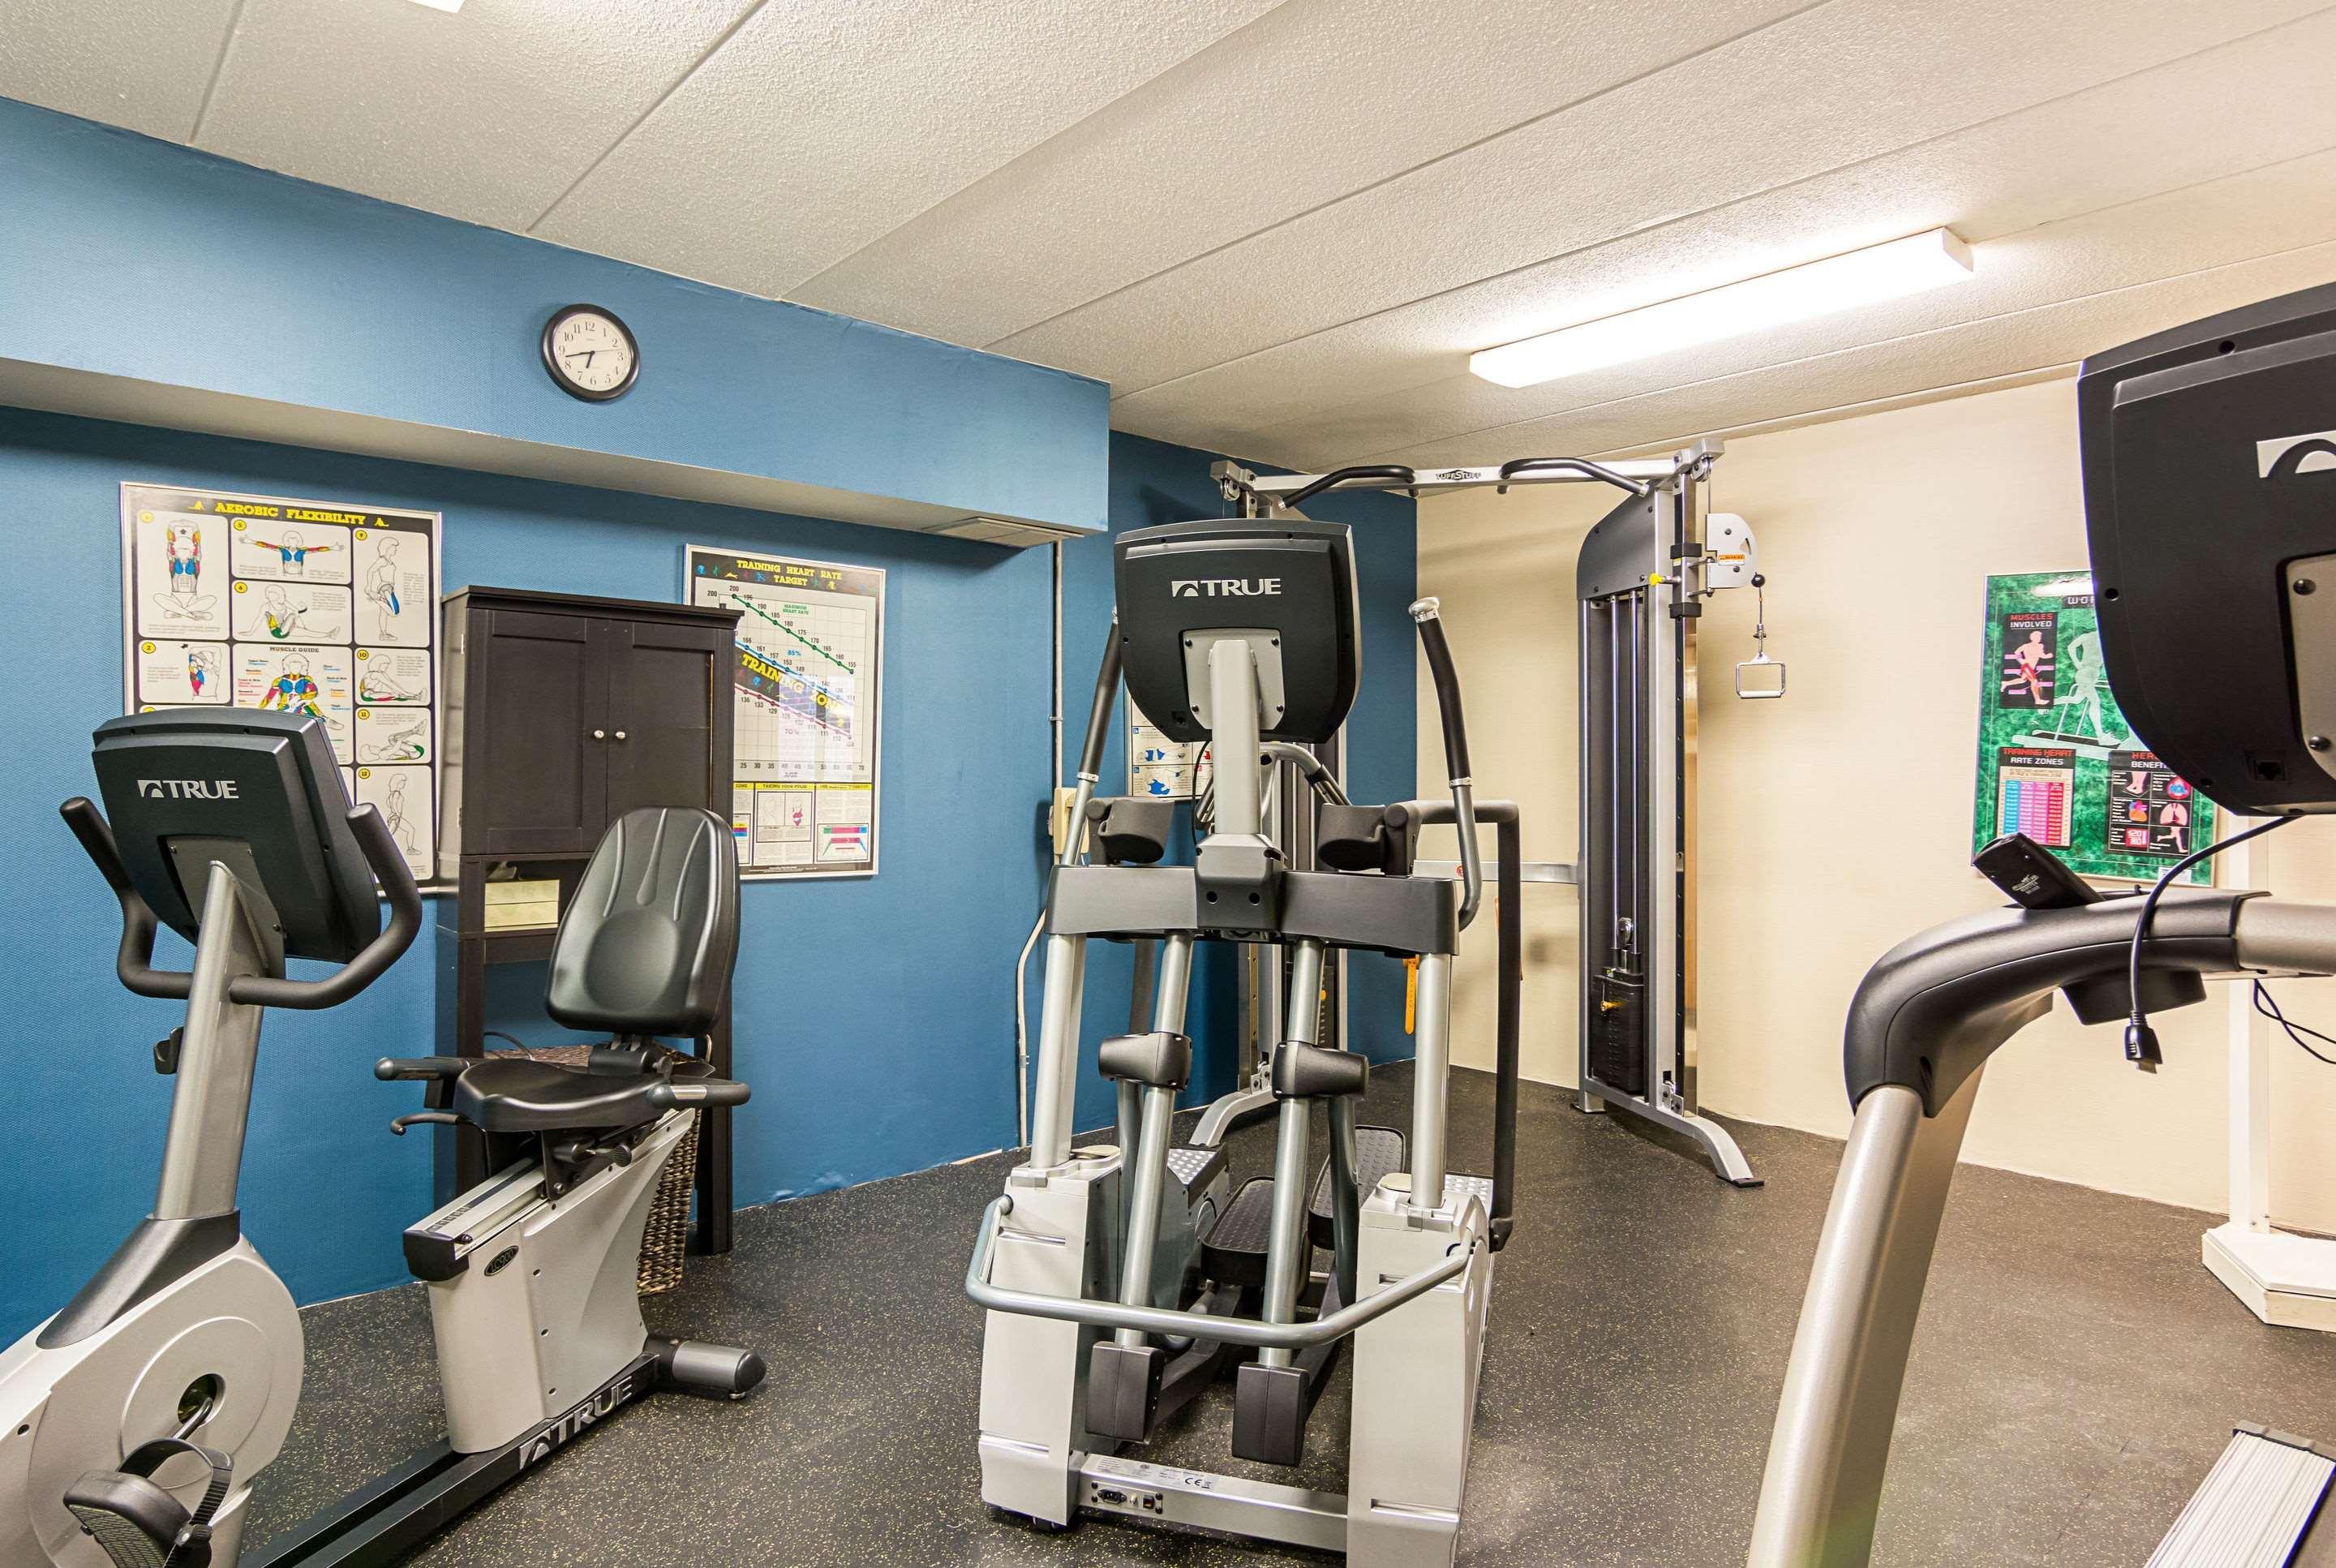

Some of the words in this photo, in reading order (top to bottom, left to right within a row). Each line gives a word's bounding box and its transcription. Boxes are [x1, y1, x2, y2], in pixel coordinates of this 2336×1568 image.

[573, 324, 581, 334] 11
[585, 321, 595, 332] 12
[603, 327, 608, 337] 1
[564, 332, 574, 342] 10
[612, 338, 618, 348] 2
[558, 346, 565, 356] 9
[617, 351, 624, 362] 3
[565, 359, 572, 371] 8
[577, 371, 584, 381] 7
[590, 376, 597, 385] 6
[604, 374, 611, 384] 5
[215, 501, 279, 519] AEROBIC
[286, 508, 367, 526] FLEXIBILITY
[736, 560, 781, 574] TRAINING
[786, 566, 815, 578] HEART
[821, 570, 842, 581] RATE
[774, 575, 808, 586] TARGET
[1200, 578, 1282, 596] TRUE
[741, 653, 805, 694] TRAINING
[161, 780, 239, 799] TRUE
[550, 1376, 633, 1444] TRUE
